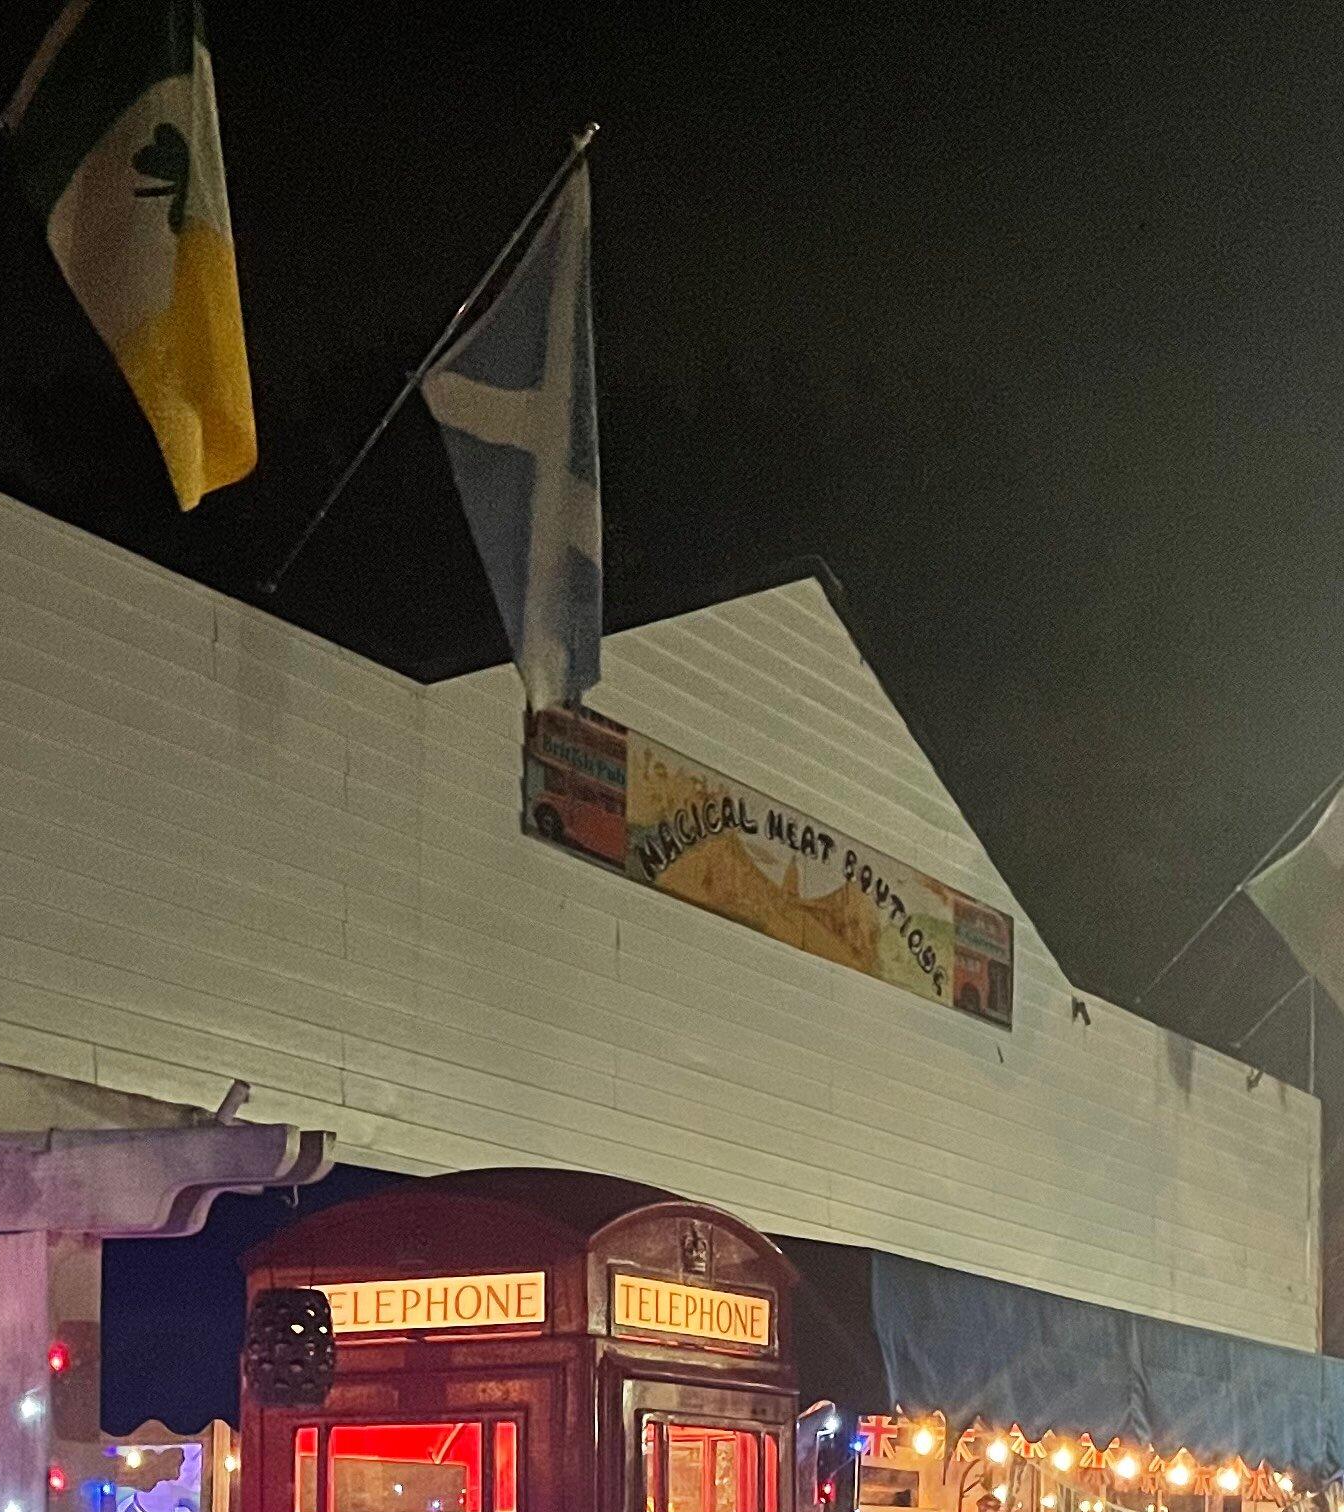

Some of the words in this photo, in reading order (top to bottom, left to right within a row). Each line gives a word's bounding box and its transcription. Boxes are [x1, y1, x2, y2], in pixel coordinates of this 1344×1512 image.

[766, 809, 835, 863] MEAT
[327, 1282, 539, 1326] ELEPHONE
[620, 1283, 764, 1339] TELEPHONE
